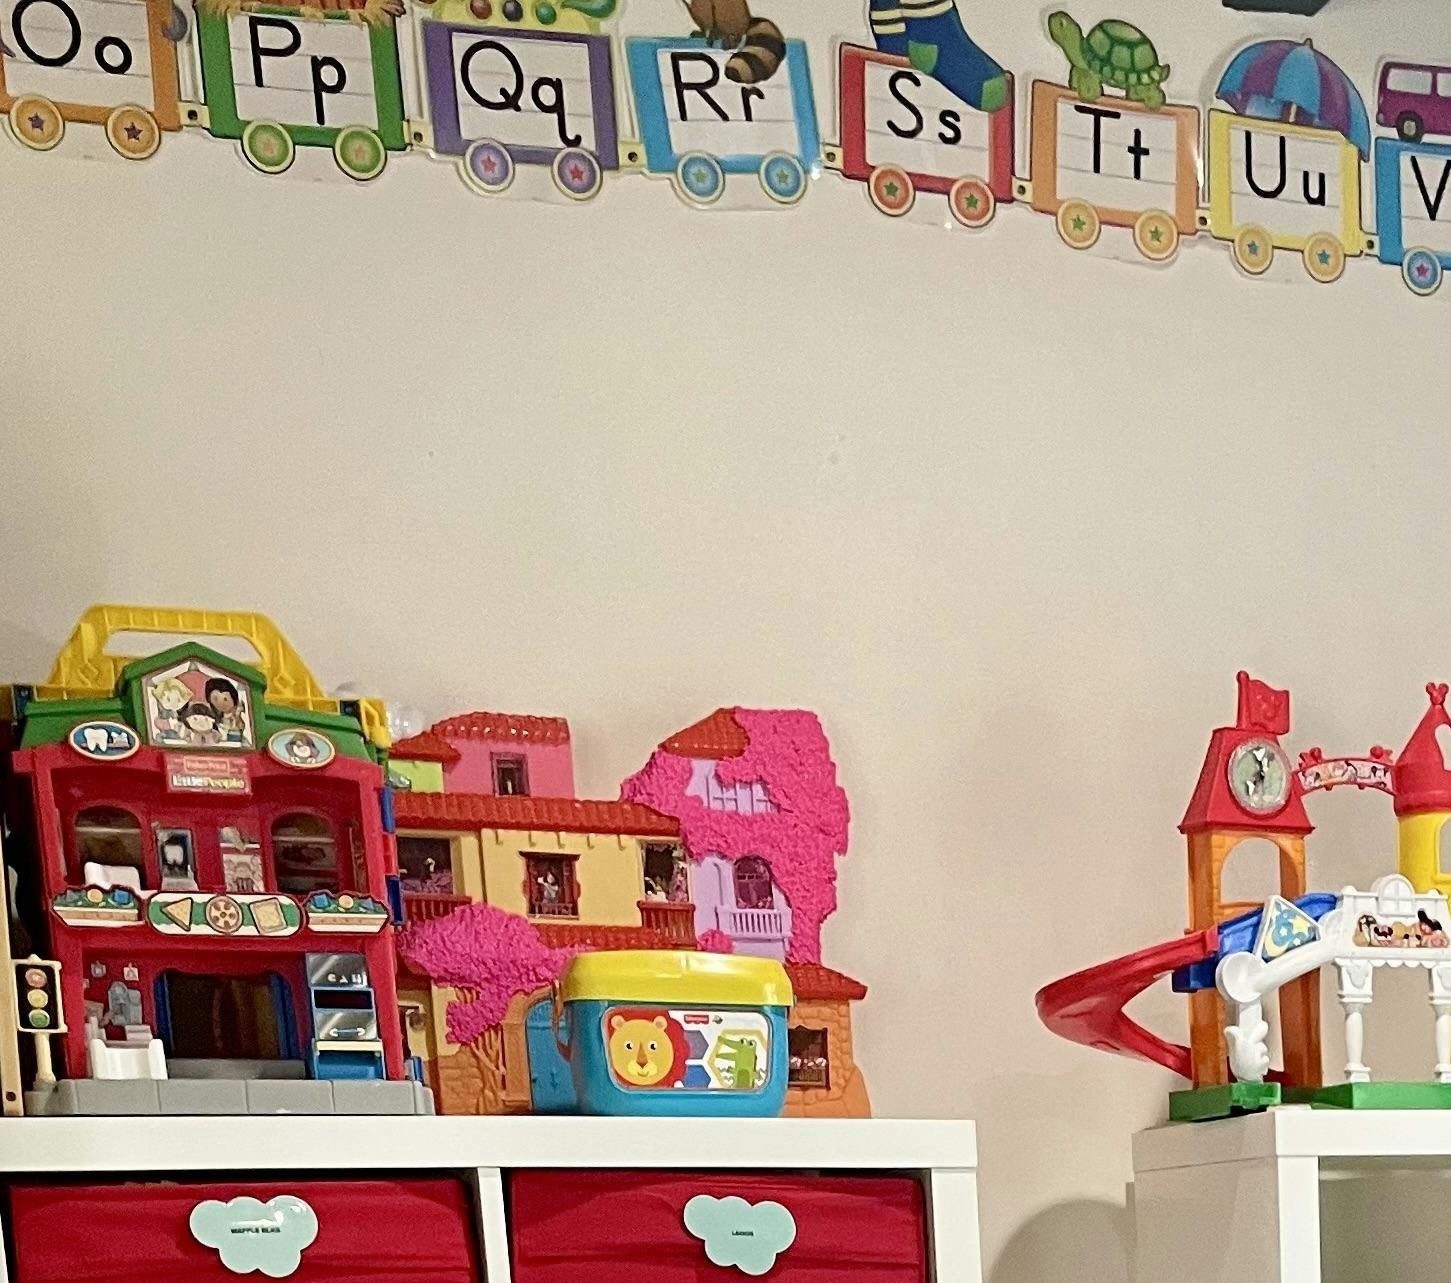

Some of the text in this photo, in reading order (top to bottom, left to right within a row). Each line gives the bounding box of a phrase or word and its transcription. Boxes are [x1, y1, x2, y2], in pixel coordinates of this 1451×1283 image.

[12, 0, 133, 75] Oo
[248, 16, 347, 126] Pp
[460, 40, 582, 148] Qq
[670, 51, 766, 122] Rr
[886, 71, 962, 145] Ss
[1075, 105, 1150, 181] Tt
[1245, 131, 1326, 207] Uu
